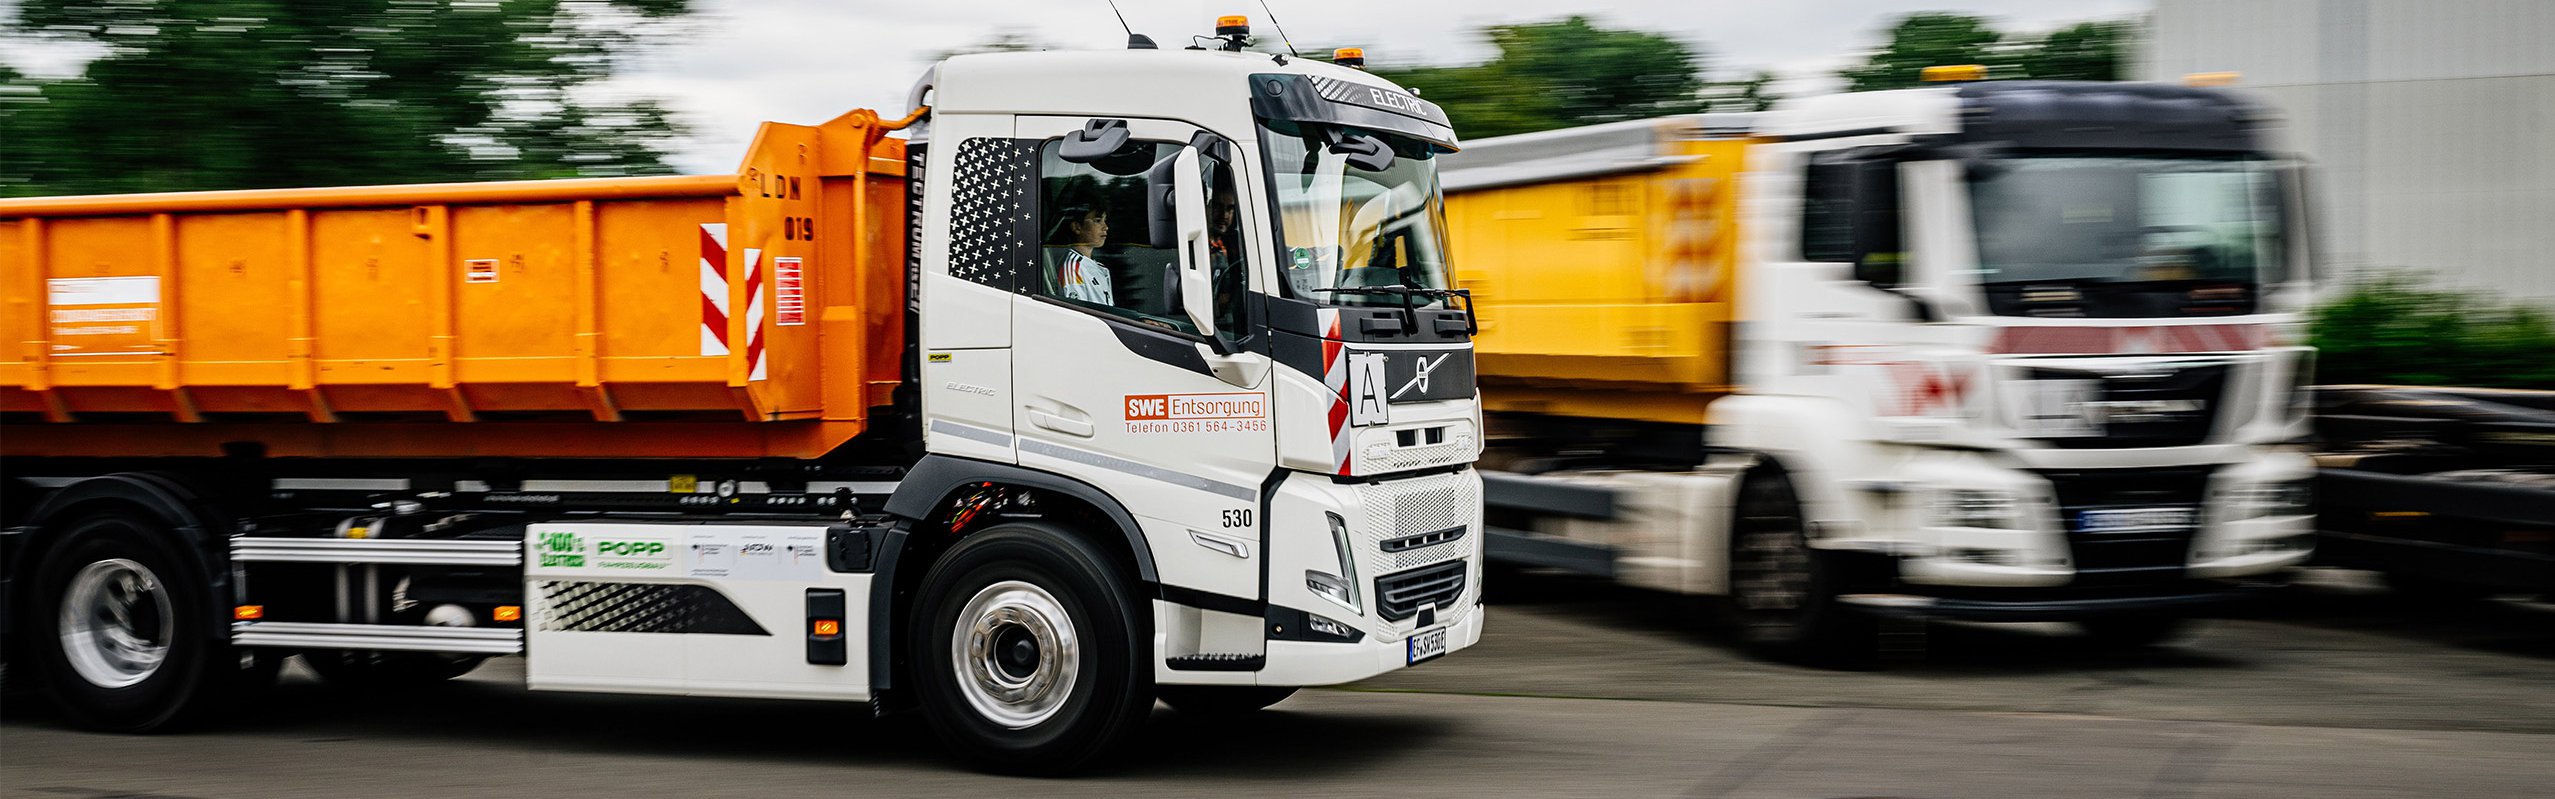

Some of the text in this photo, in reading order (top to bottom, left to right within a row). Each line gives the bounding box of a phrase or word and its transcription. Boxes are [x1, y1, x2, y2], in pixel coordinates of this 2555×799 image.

[1370, 88, 1427, 116] ELECTRIC
[911, 152, 925, 258] TECTRUM
[784, 216, 814, 241] 019
[946, 382, 996, 397] ELECTRIC
[1360, 363, 1380, 415] A
[1128, 398, 1260, 417] SWE Entsorgung
[1125, 420, 1267, 433] Telefon 0361 564-3456
[1222, 509, 1253, 528] 530
[598, 541, 665, 556] POPP
